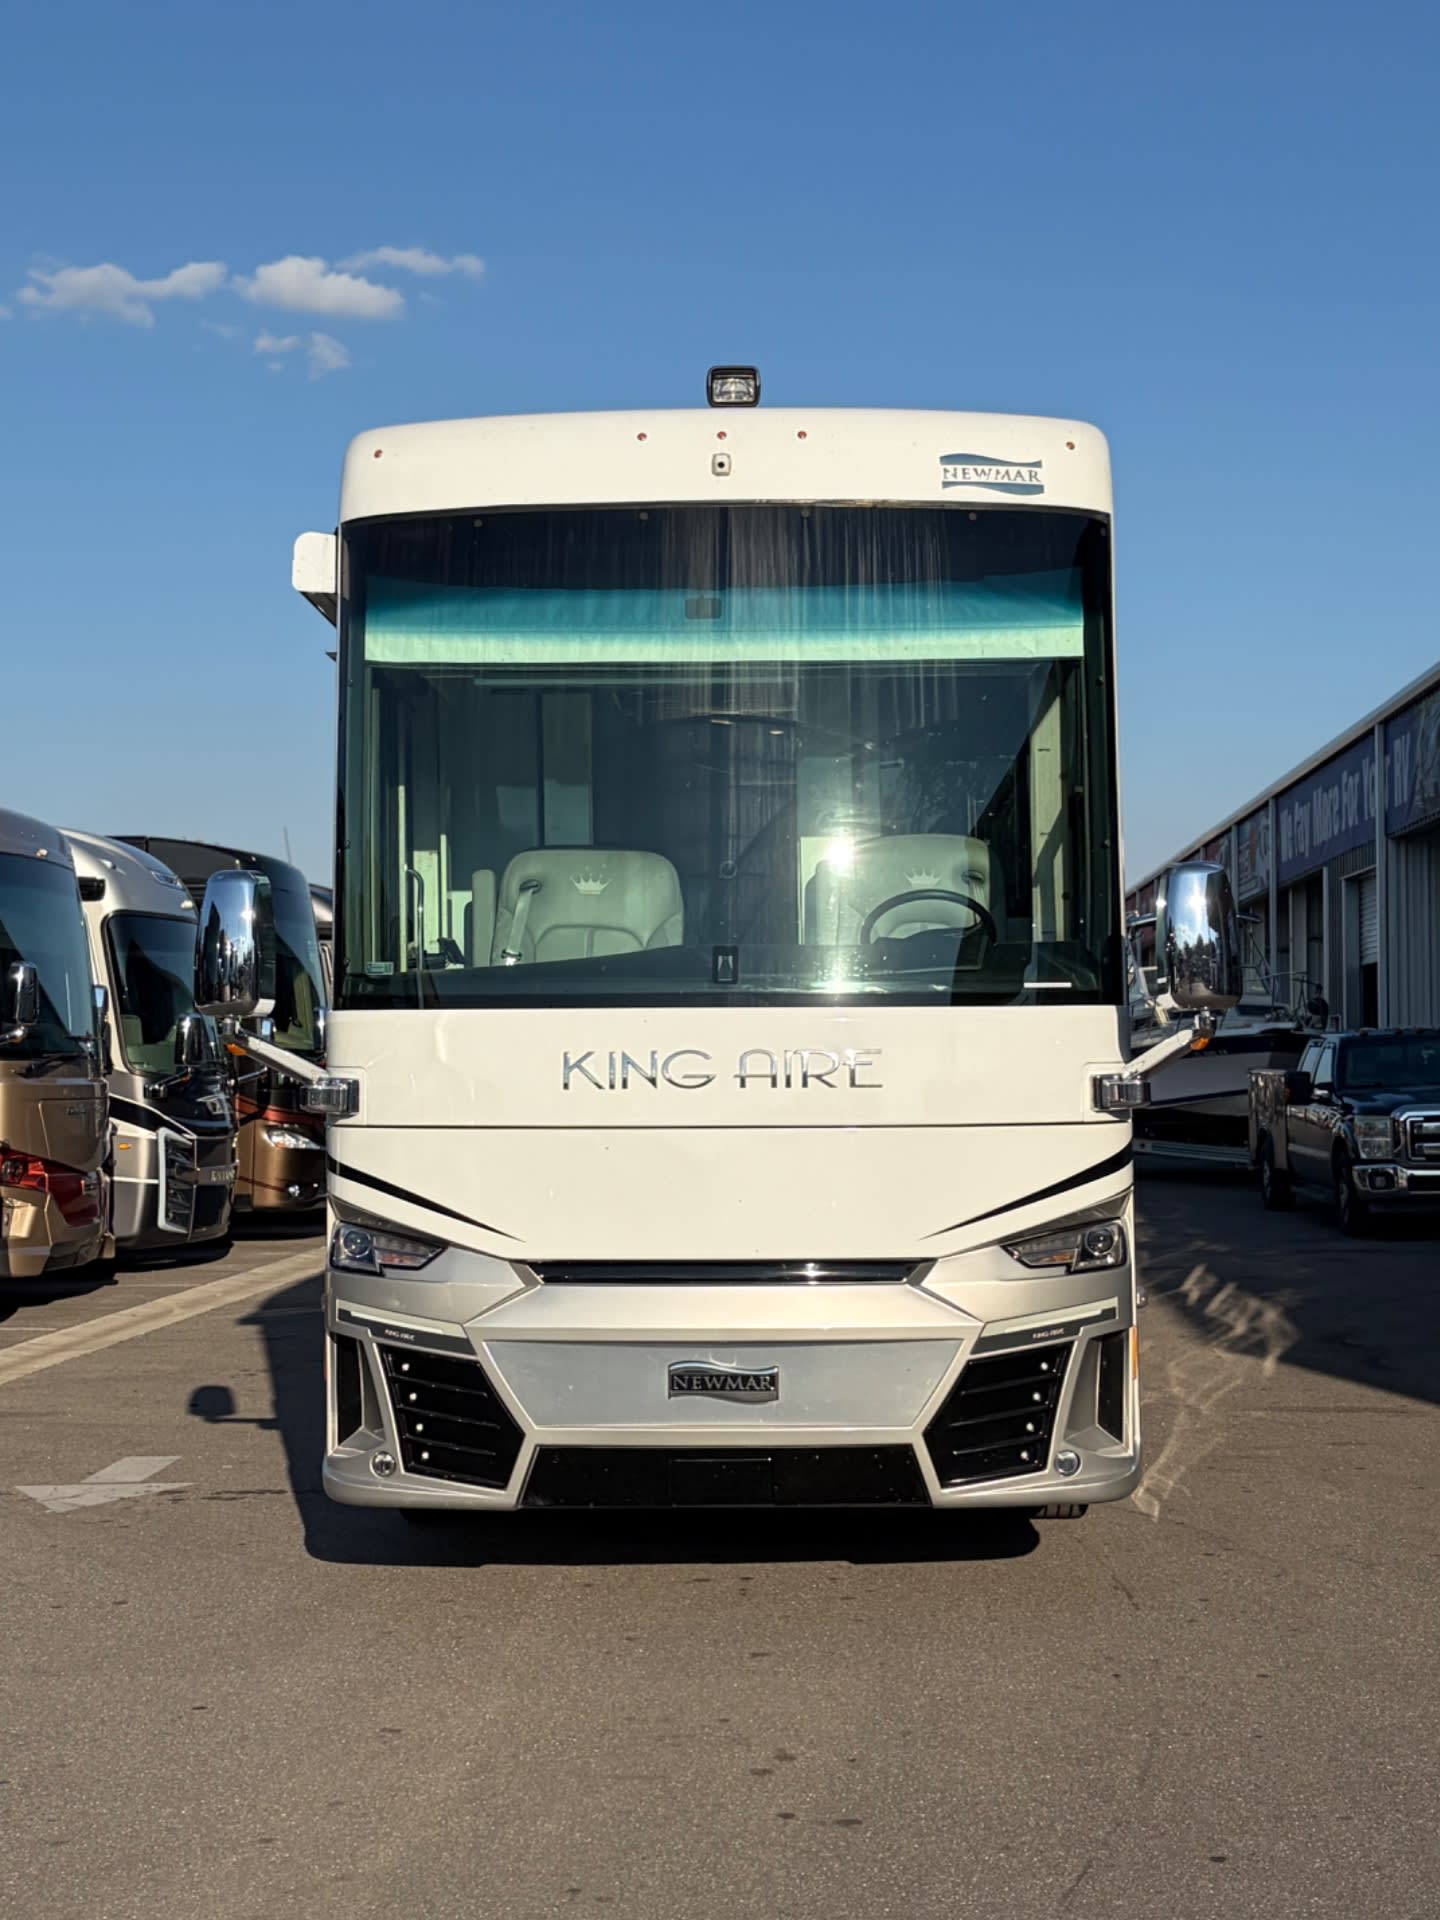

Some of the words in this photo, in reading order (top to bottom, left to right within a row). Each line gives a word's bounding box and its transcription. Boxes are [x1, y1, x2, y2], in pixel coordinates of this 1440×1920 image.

[943, 467, 1041, 482] NEWMAR
[1313, 786, 1340, 848] More
[1341, 770, 1360, 831] For
[1362, 756, 1391, 821] Yor
[1393, 731, 1411, 807] RV
[563, 1049, 716, 1090] KING
[733, 1048, 883, 1090] AIRE
[672, 1375, 775, 1390] NEWMAR
